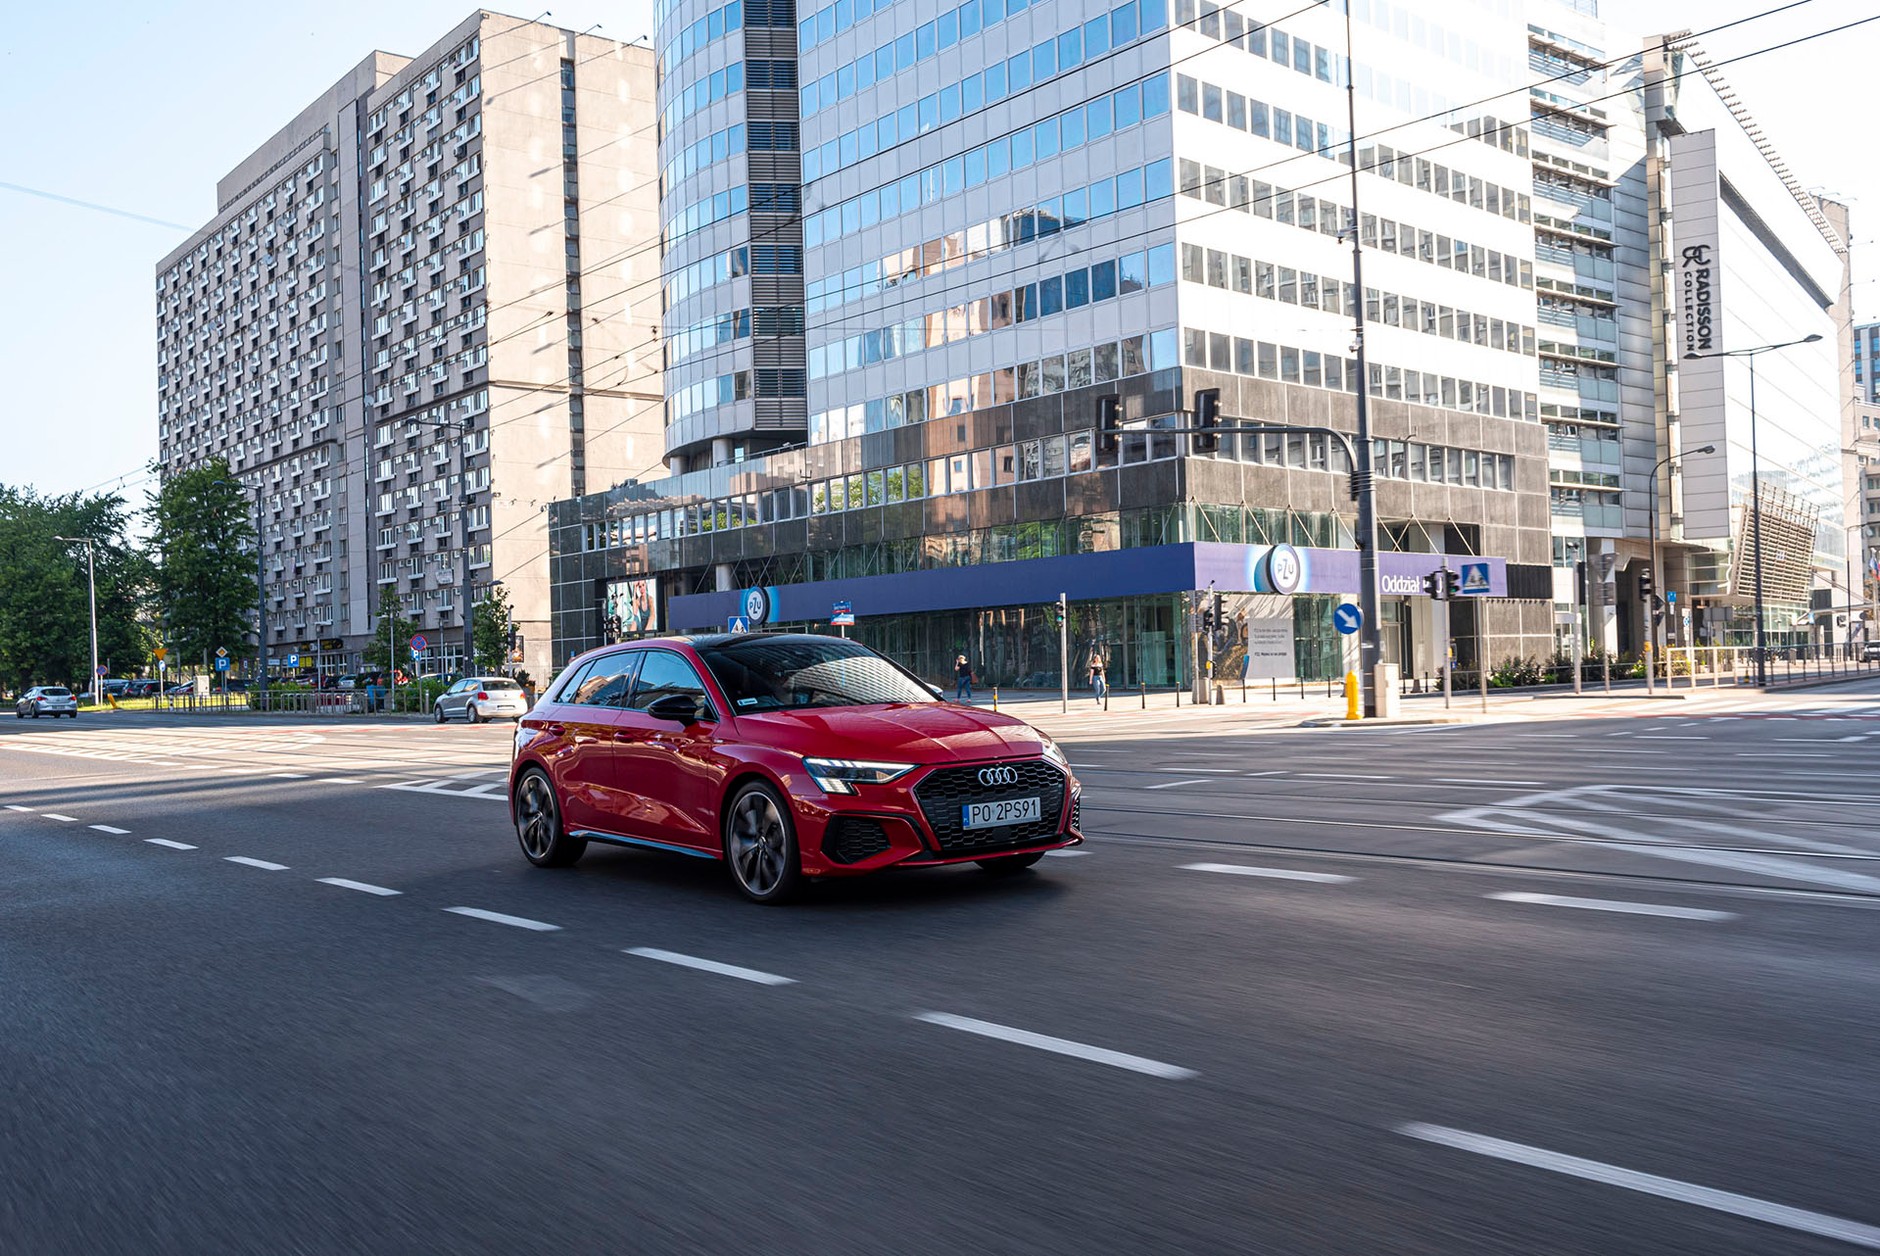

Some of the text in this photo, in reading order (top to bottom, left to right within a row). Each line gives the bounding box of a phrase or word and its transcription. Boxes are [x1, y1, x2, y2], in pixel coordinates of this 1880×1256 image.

[1684, 271, 1694, 351] COLLECTION
[1696, 267, 1712, 350] RADISSON
[1278, 558, 1294, 579] PZU
[1381, 575, 1420, 593] Oddział
[749, 597, 762, 614] PZU
[219, 660, 227, 669] P
[290, 655, 297, 664] P
[972, 799, 1036, 824] PO 2PS91
